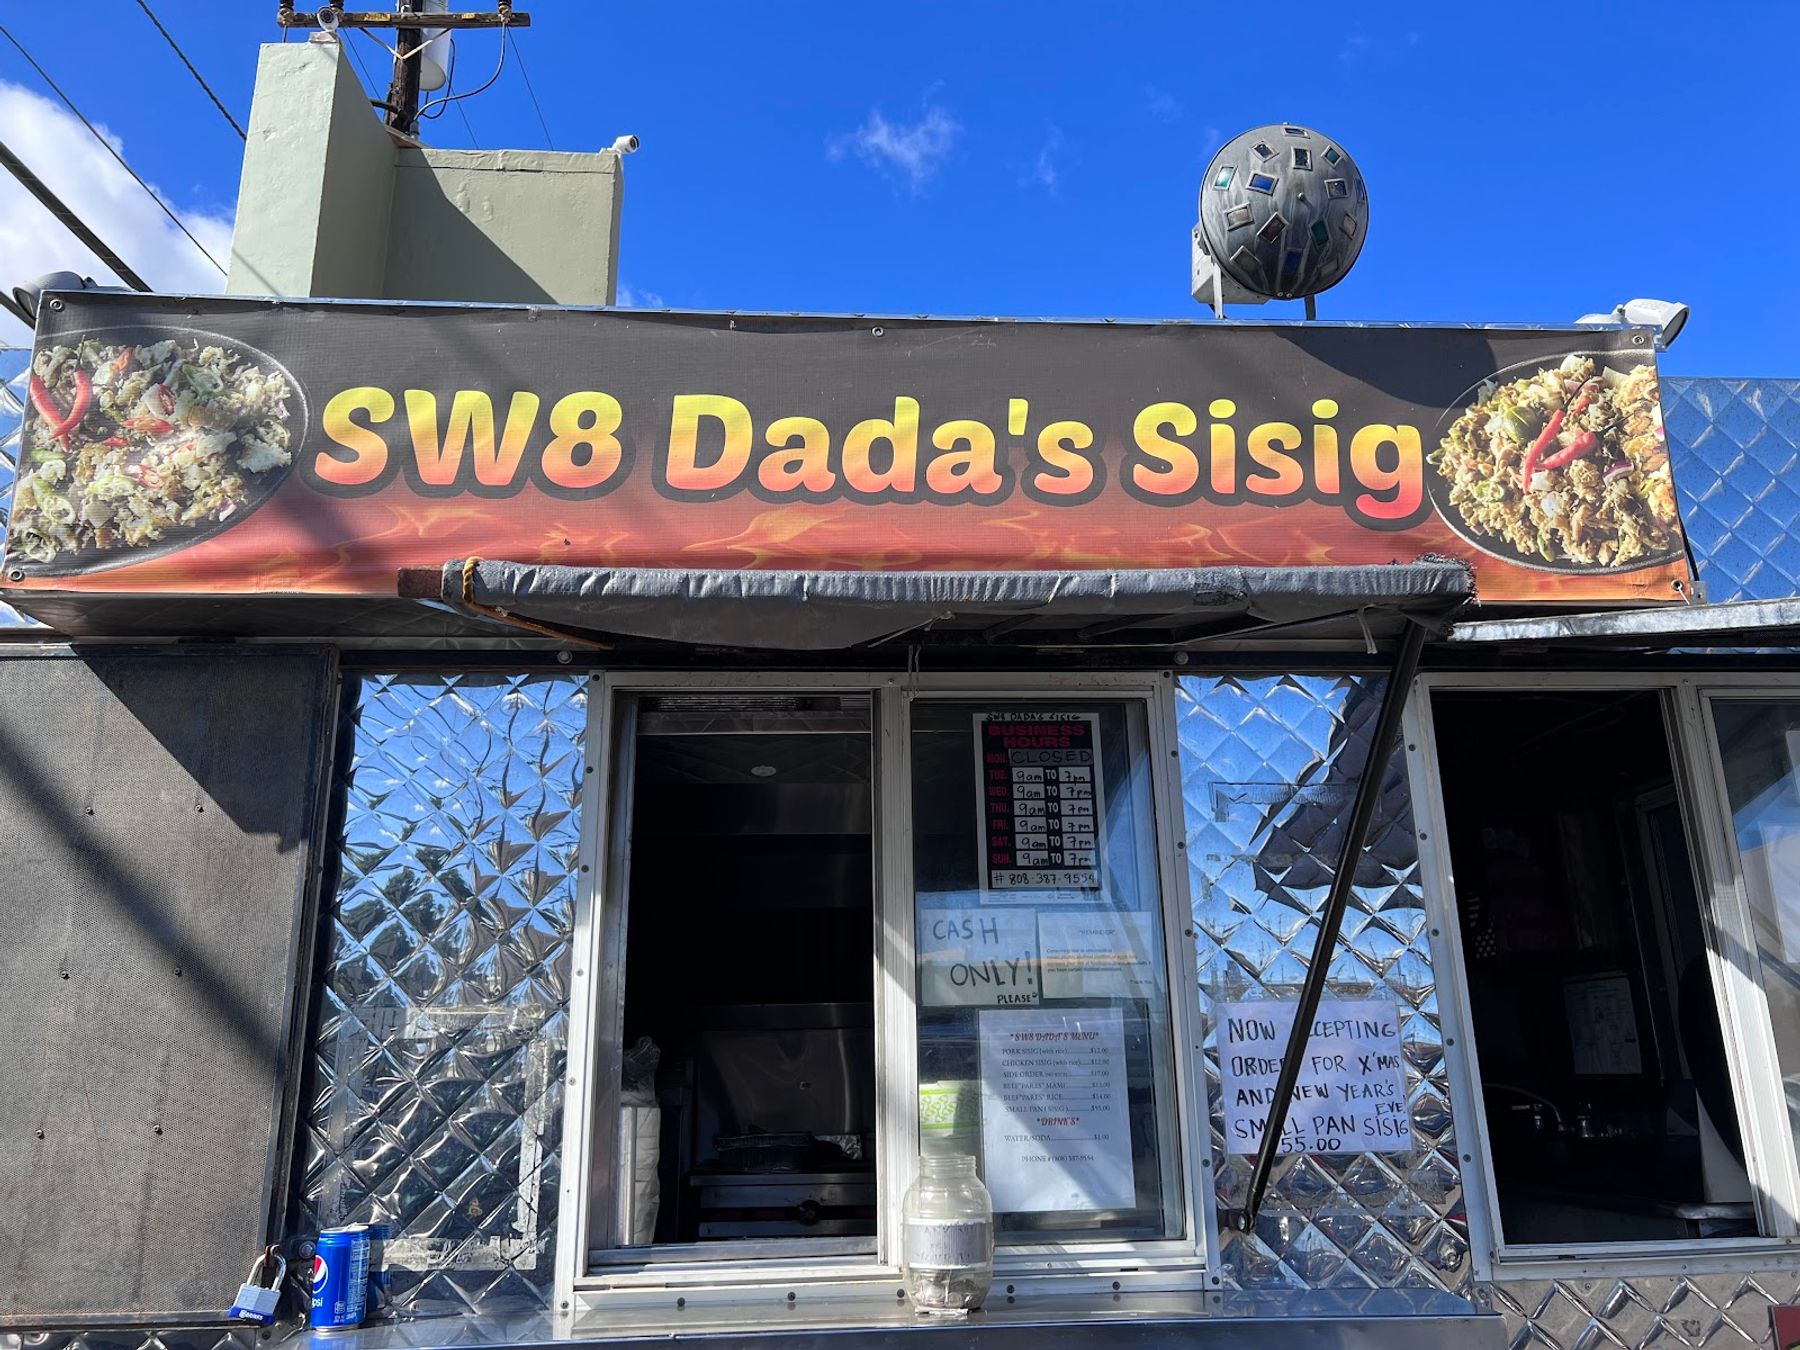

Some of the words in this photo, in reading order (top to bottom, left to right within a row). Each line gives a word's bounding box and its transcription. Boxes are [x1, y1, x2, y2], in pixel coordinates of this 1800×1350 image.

[314, 387, 622, 488] SW8
[665, 395, 1094, 494] Dada's
[1133, 399, 1423, 519] Sisig
[987, 724, 1086, 737] BUSINESS
[1003, 736, 1072, 748] HOURS
[1011, 751, 1092, 764] CLOSED
[1045, 769, 1057, 780] TO
[1046, 786, 1058, 797] TO
[1047, 802, 1059, 813] TO
[1048, 819, 1060, 830] TO
[1049, 836, 1061, 847] TO
[1050, 853, 1062, 864] TO
[993, 873, 1004, 883] #
[933, 917, 998, 944] CASH
[950, 951, 1033, 987] ONLY!
[997, 994, 1031, 1004] PLEASE
[1228, 1018, 1276, 1043] NOW
[1310, 1020, 1396, 1039] CEPTING
[1312, 1055, 1347, 1075] FOR
[1358, 1052, 1400, 1075] X'MAS
[1236, 1087, 1277, 1107] AND
[1290, 1083, 1329, 1104] NEW
[1336, 1079, 1394, 1101] YEAR'S
[1235, 1117, 1304, 1139] SMLL
[1312, 1115, 1356, 1135] PAN
[1021, 1154, 1047, 1162] PHONE
